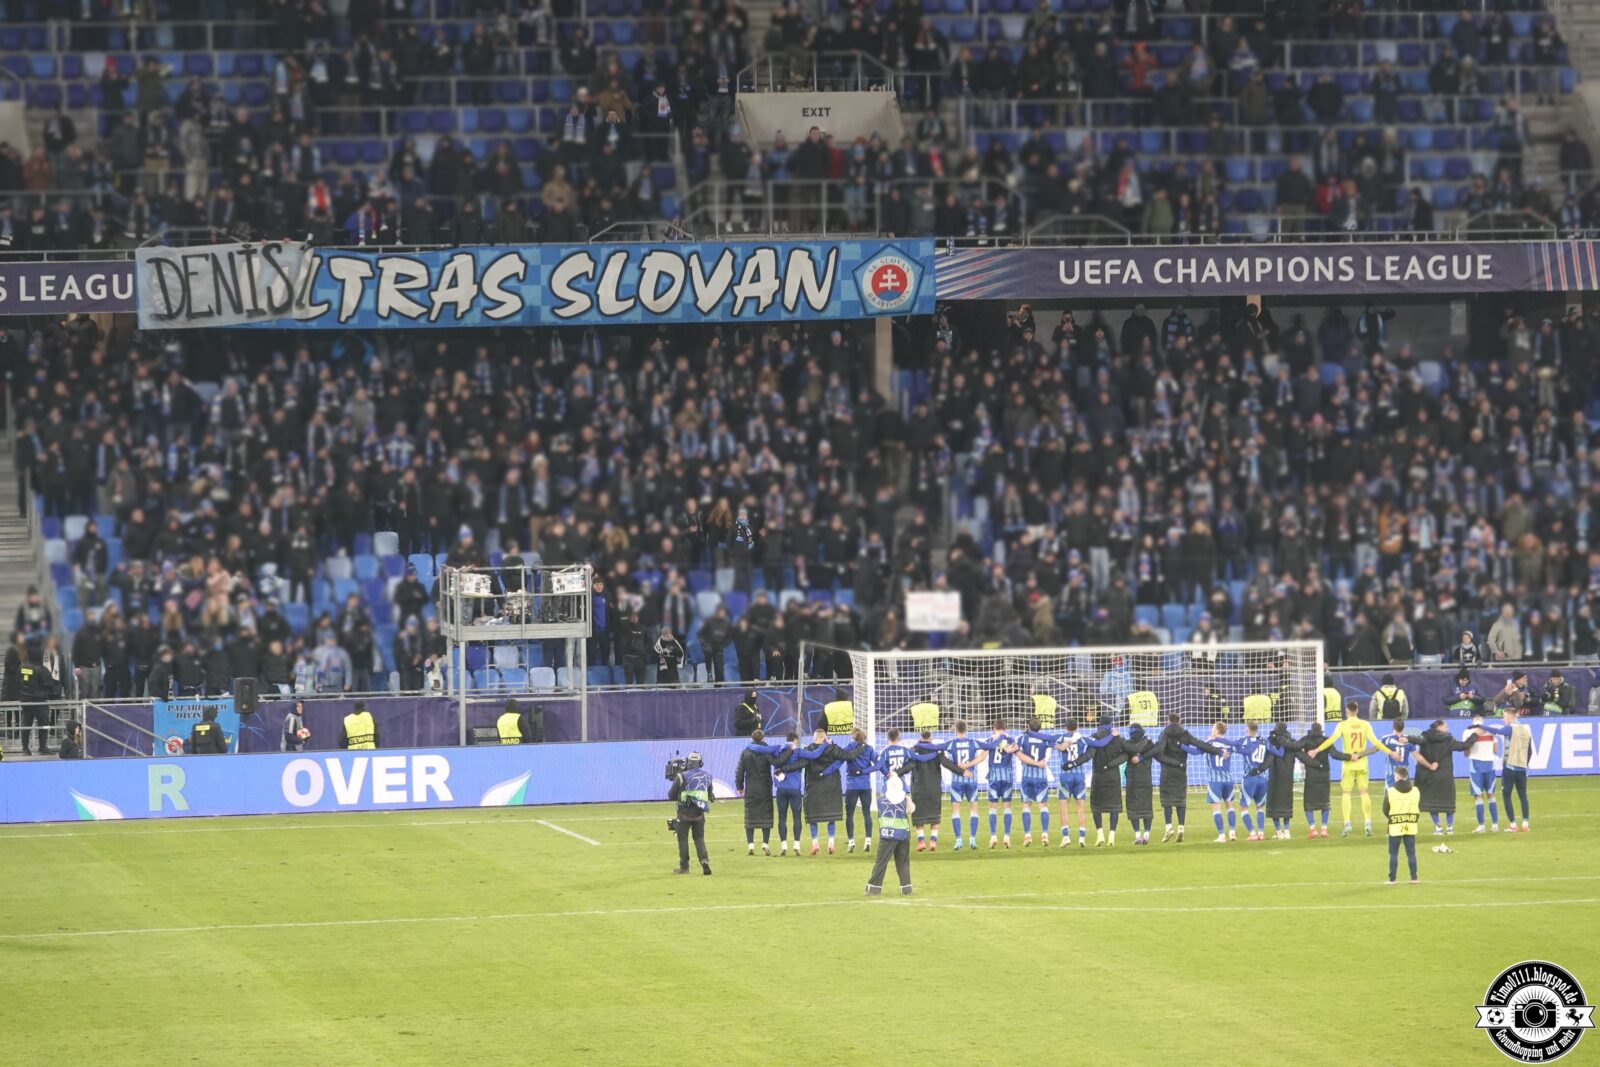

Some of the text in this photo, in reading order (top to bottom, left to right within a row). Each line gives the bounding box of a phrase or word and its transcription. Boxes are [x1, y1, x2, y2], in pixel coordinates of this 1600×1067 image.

[802, 107, 831, 117] EXIT
[147, 244, 295, 319] DENIS
[550, 247, 838, 319] SLOVAN
[1059, 254, 1493, 285] UEFA CHAMPIONS LEAGUE
[148, 764, 190, 812] R
[281, 754, 454, 807] OVER
